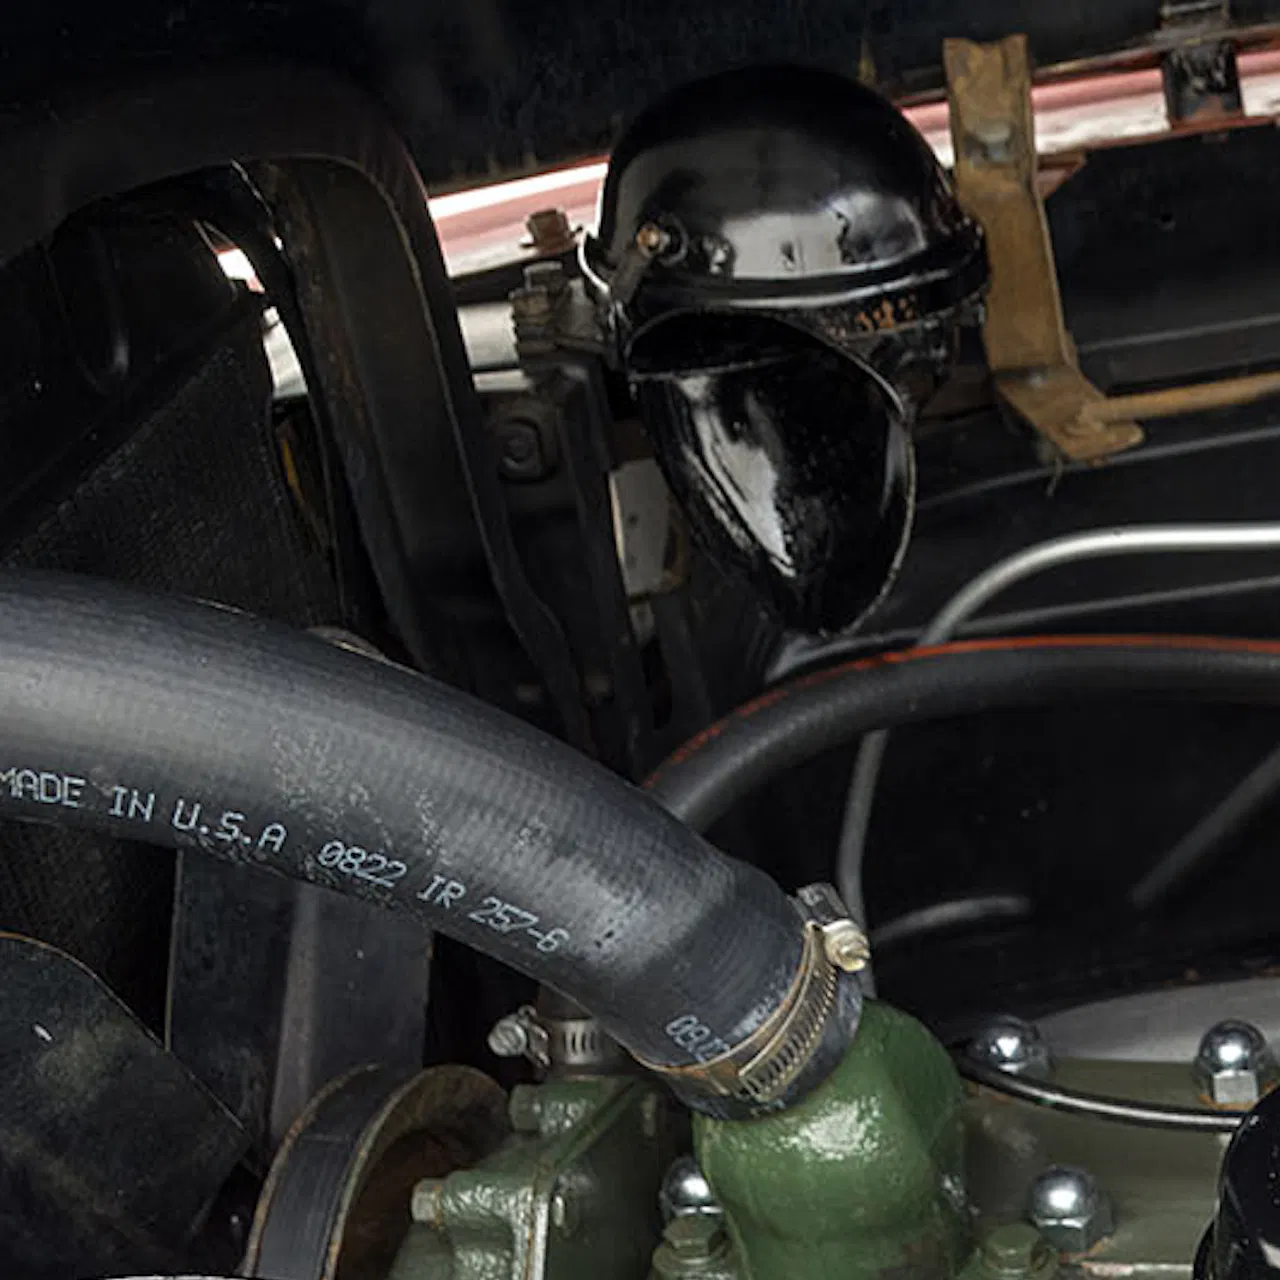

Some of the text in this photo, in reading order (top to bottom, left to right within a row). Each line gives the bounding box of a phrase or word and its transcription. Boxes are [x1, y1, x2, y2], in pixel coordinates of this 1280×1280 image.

[0, 767, 570, 952] MADE IN U.S.A 0822 IR 257-6
